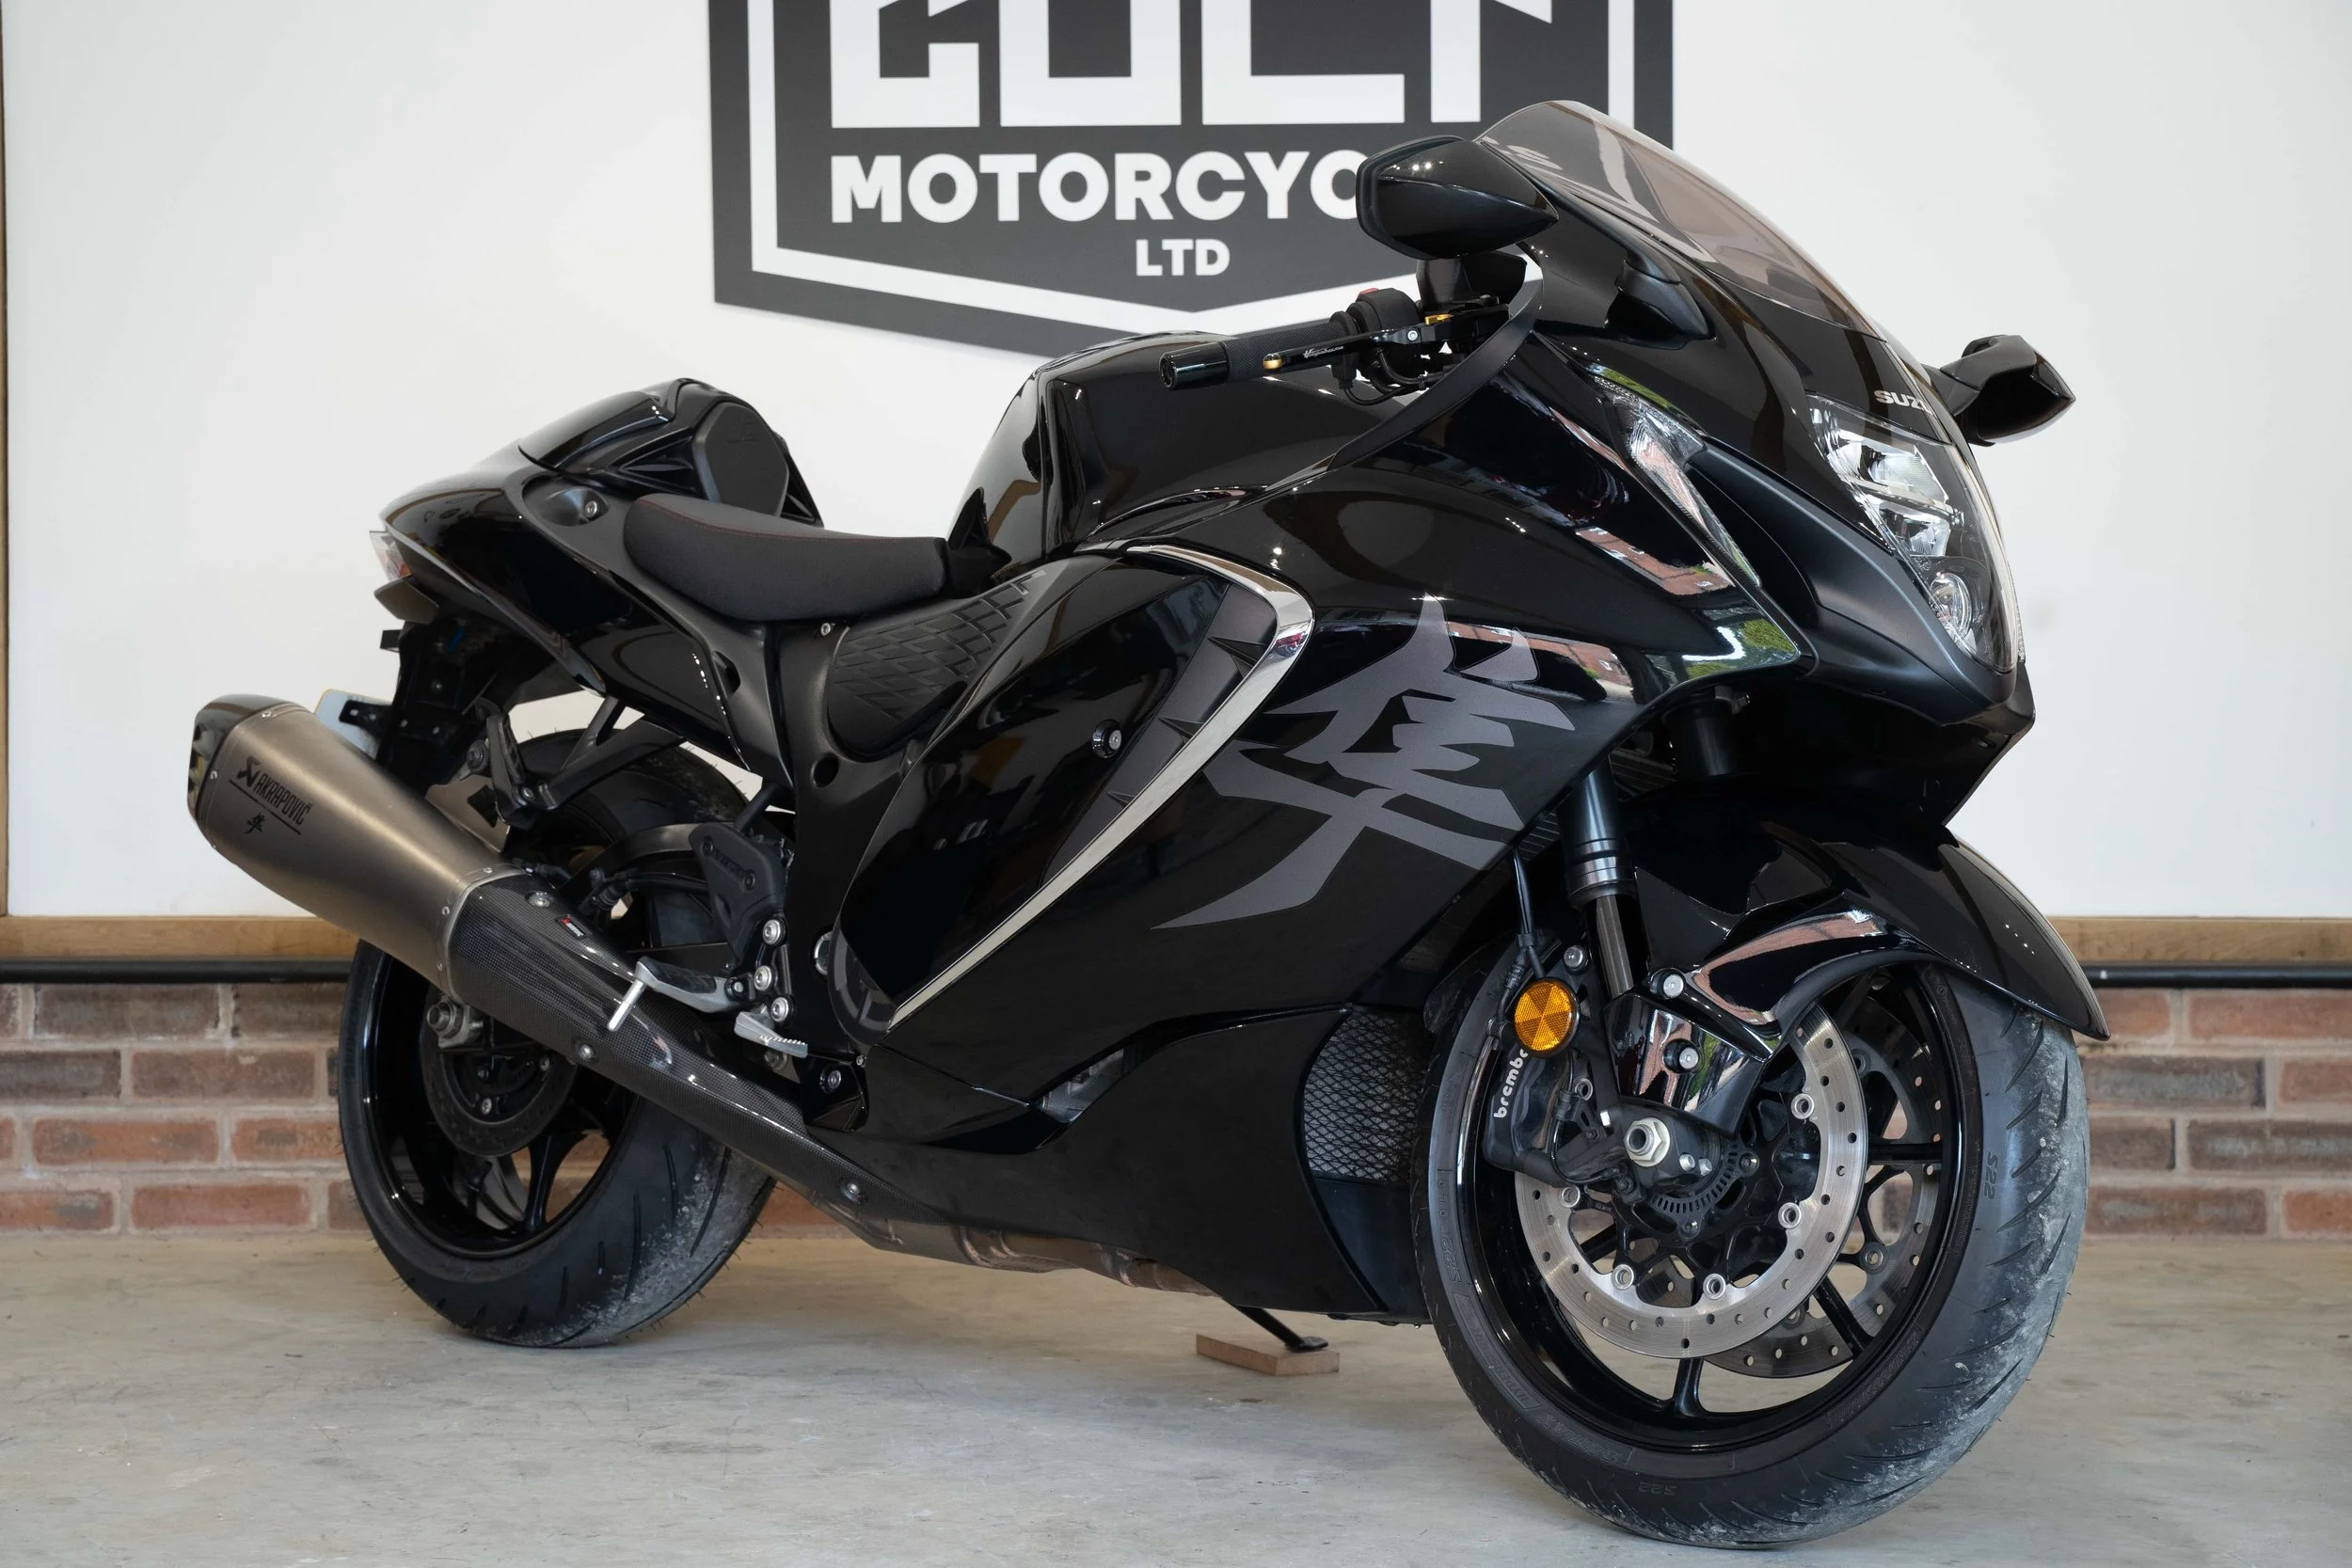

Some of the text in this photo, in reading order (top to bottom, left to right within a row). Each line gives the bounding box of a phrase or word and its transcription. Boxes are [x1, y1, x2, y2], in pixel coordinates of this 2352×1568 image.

[832, 150, 1365, 223] MOTORCYC
[1136, 239, 1231, 276] LTD
[1874, 389, 1933, 415] SUZ
[1984, 1150, 1999, 1199] S22
[1637, 1481, 1678, 1497] S22
